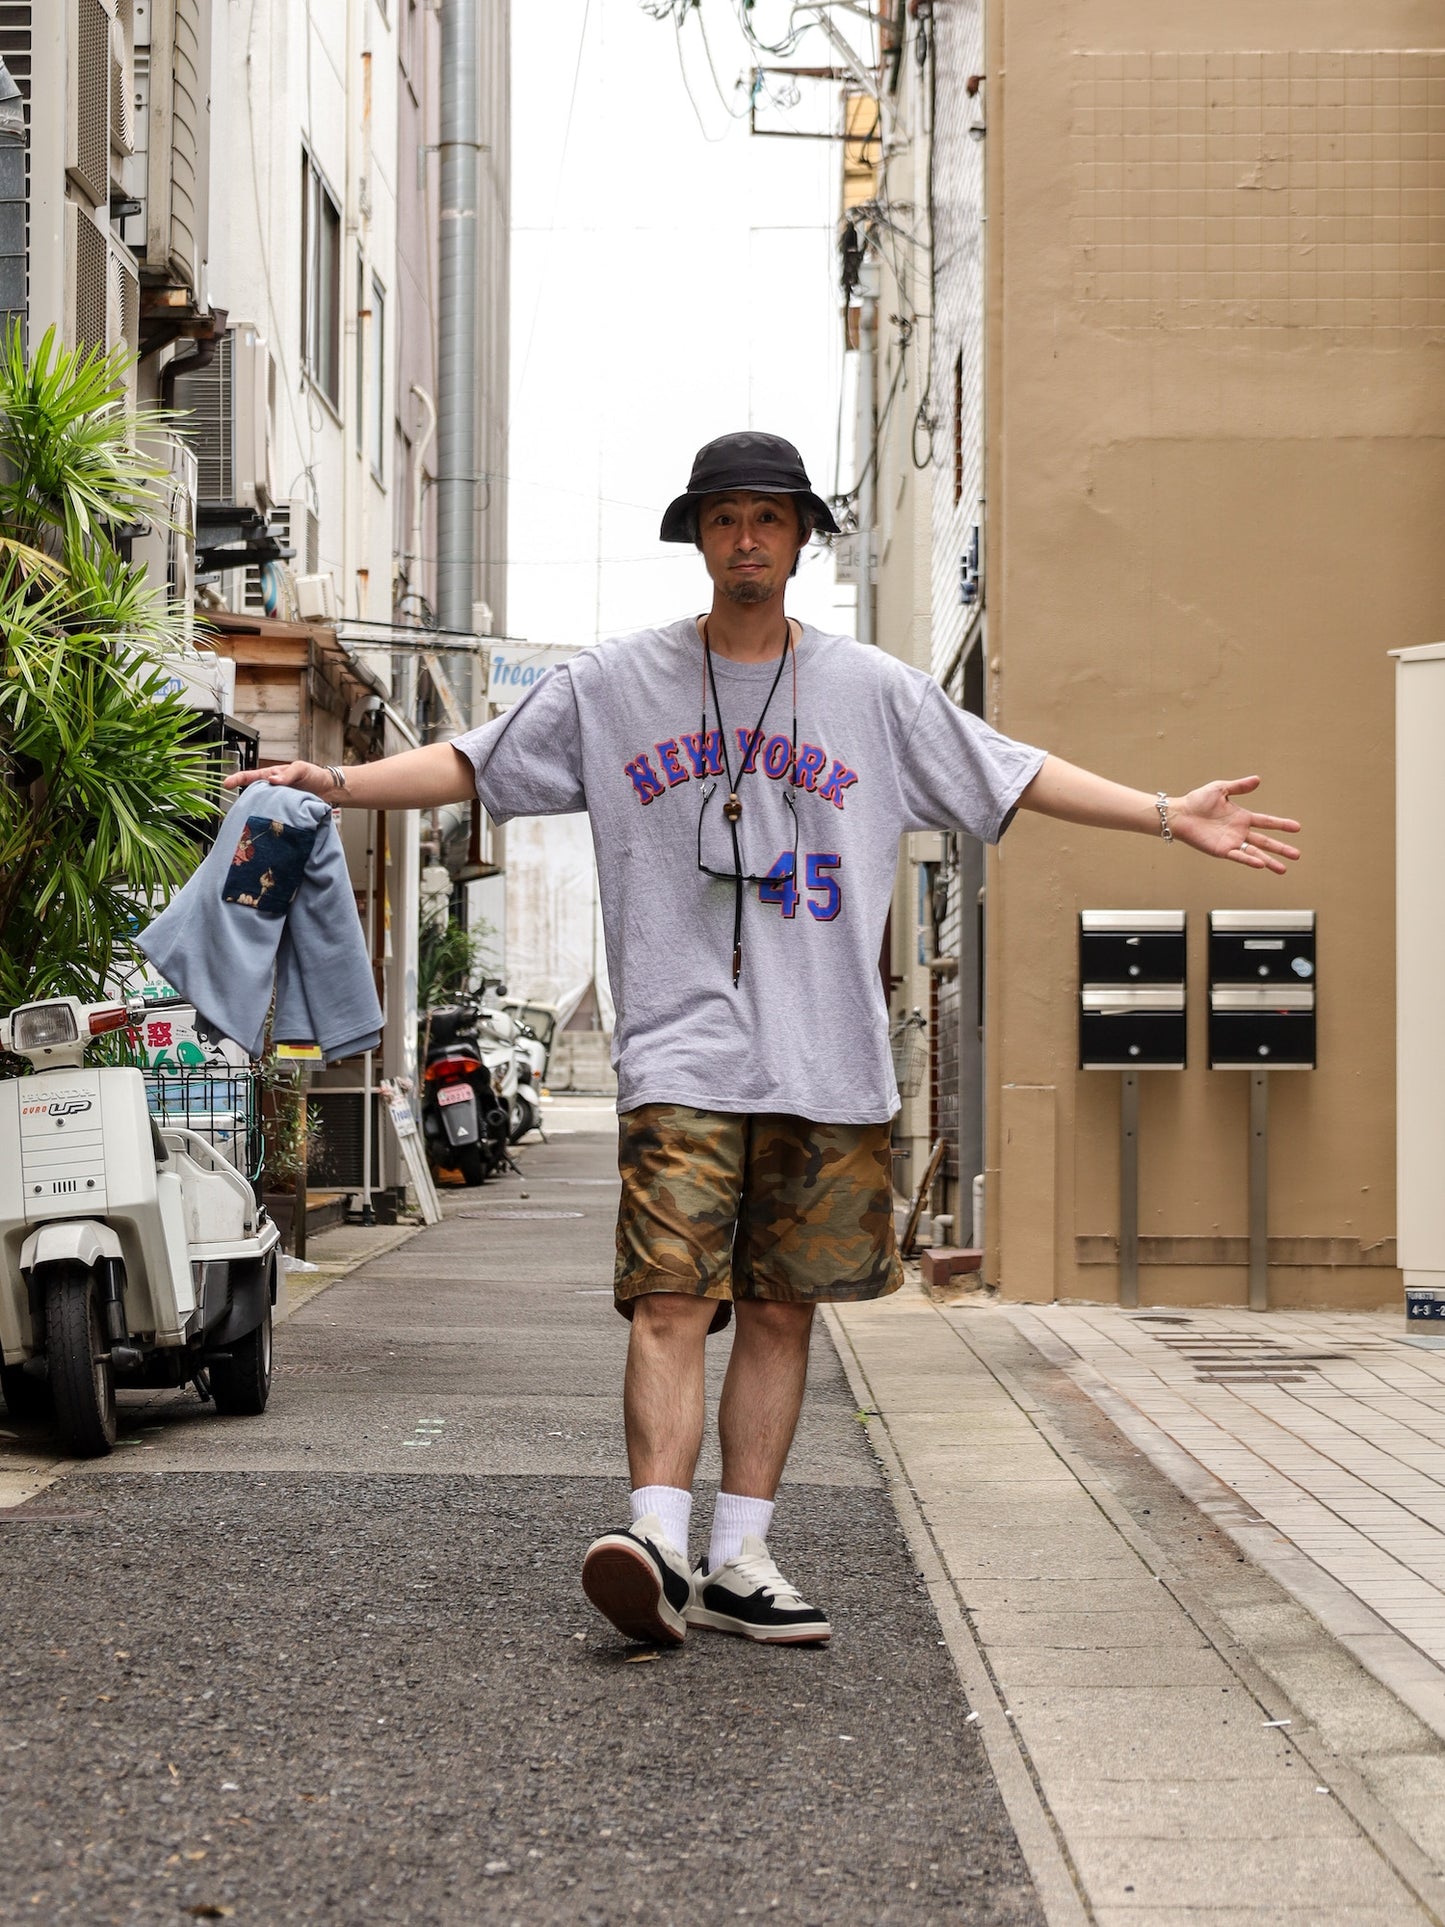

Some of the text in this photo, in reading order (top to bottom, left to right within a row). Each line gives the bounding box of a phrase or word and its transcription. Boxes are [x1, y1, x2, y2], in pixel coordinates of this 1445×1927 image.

[624, 727, 858, 809] NEW YORK
[758, 851, 841, 921] 45
[22, 1088, 97, 1103] HONDA
[48, 1100, 92, 1117] UP
